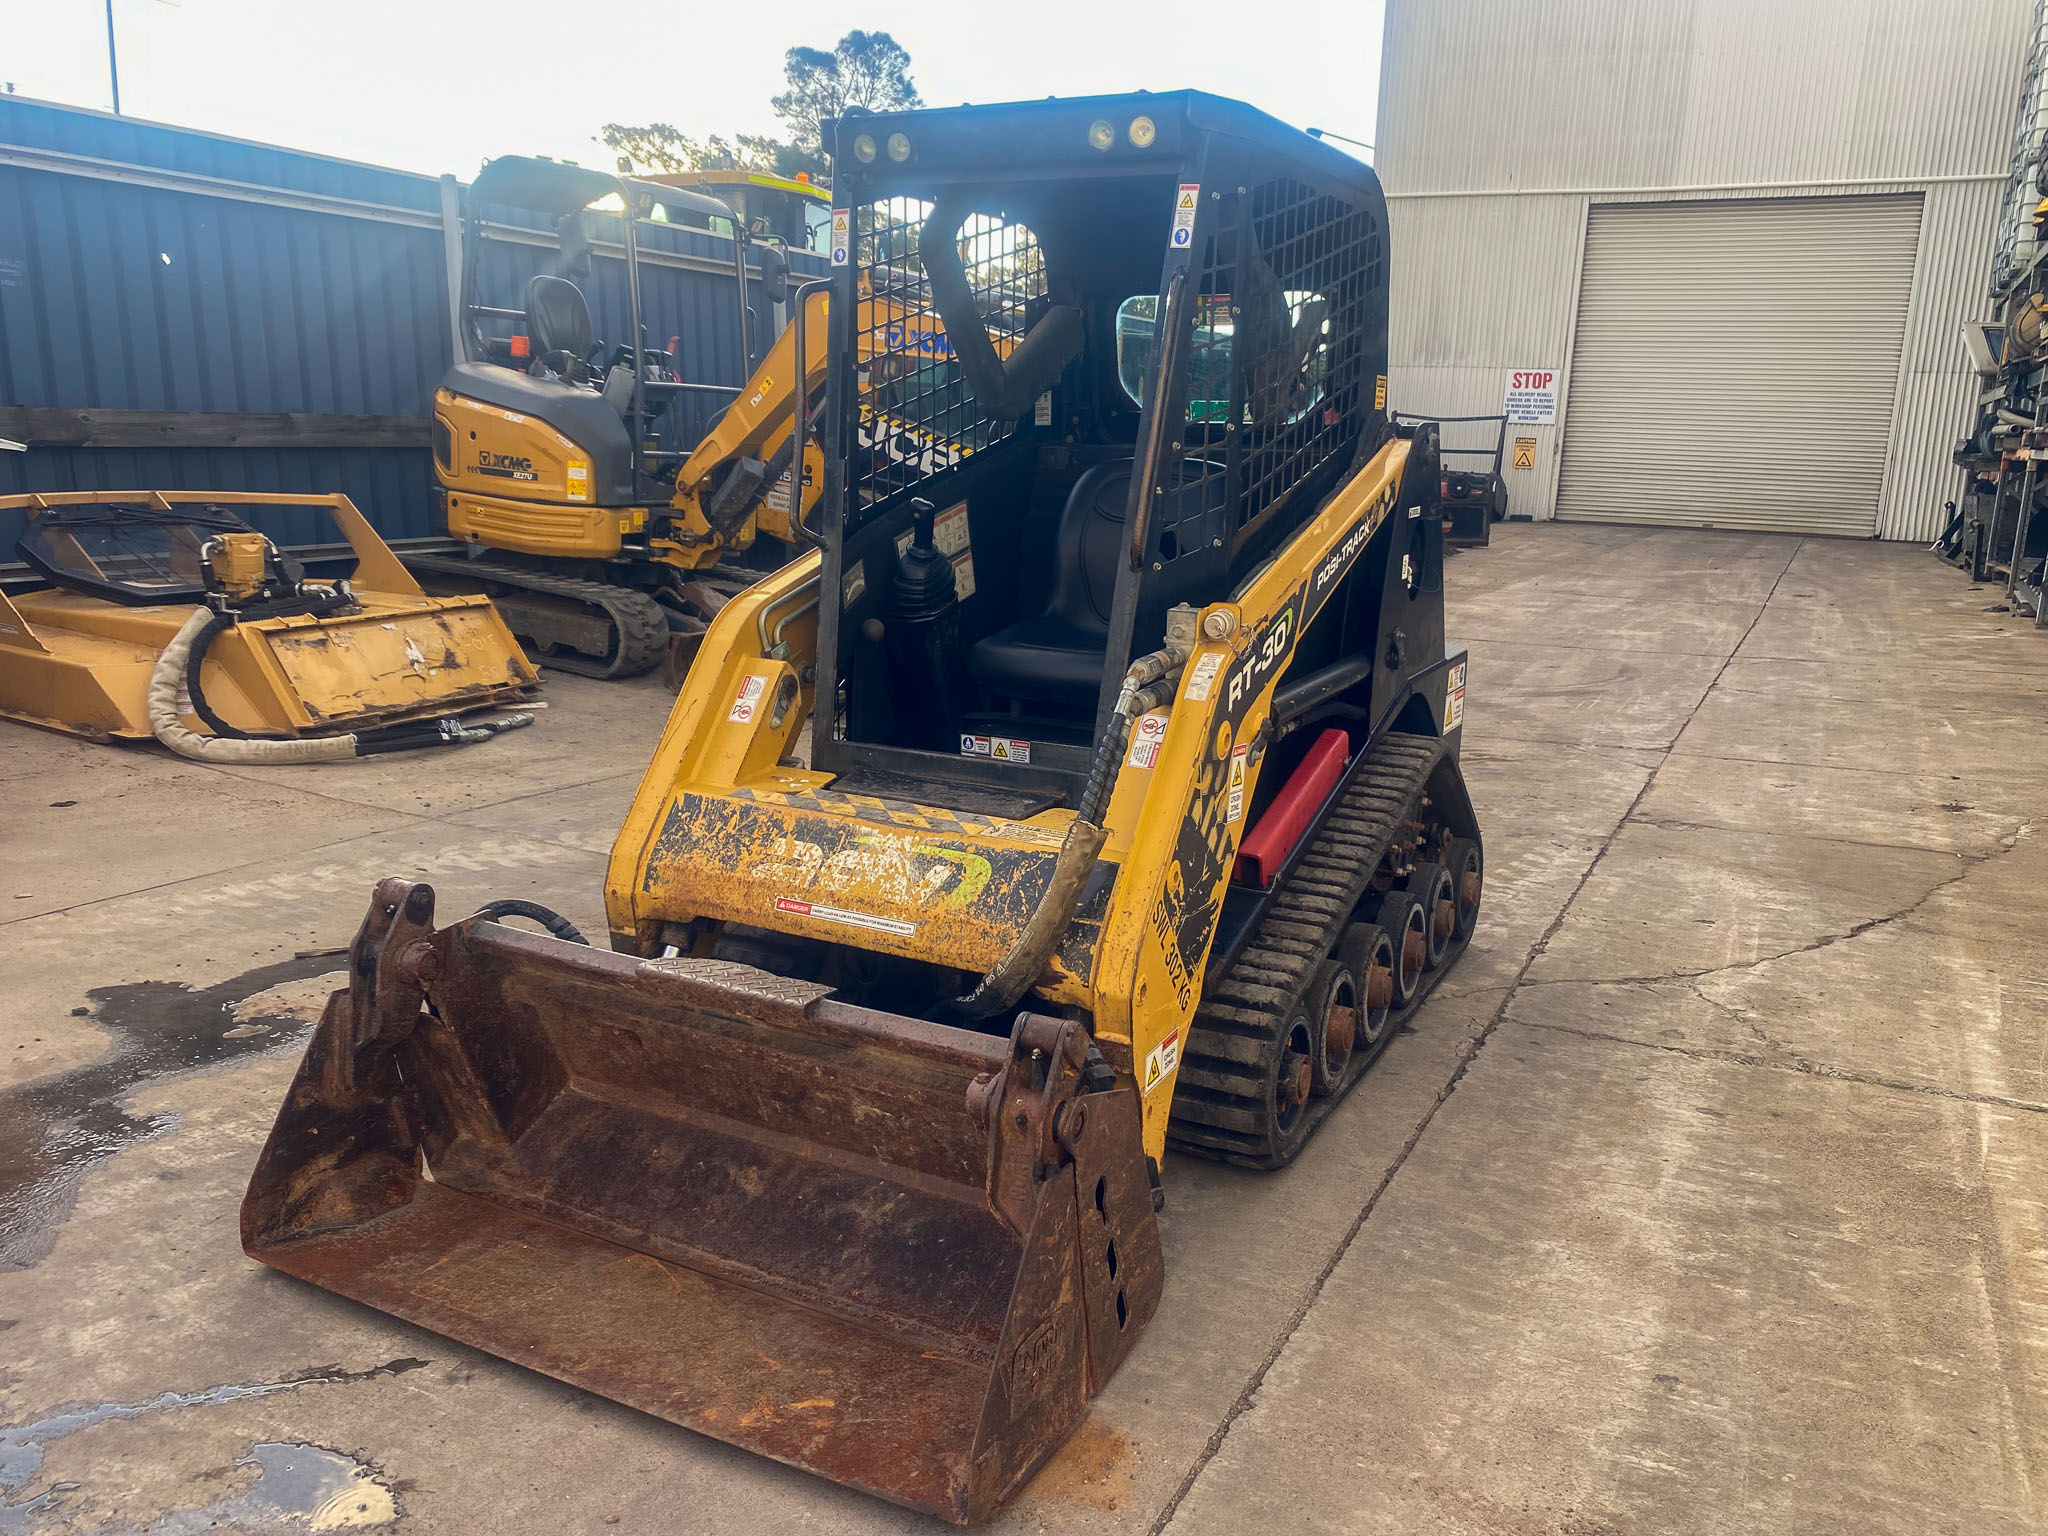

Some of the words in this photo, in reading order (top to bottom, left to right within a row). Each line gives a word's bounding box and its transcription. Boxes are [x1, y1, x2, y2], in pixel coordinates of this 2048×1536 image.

[1512, 372, 1553, 389] STOP
[493, 453, 532, 472] XCMG
[512, 471, 533, 480] XE27U
[1316, 519, 1372, 591] POSI-TRACK
[1228, 621, 1287, 713] RT-30
[786, 902, 809, 911] DANGER
[1152, 899, 1168, 949] SWL
[1164, 942, 1183, 988] 302
[1176, 982, 1192, 1014] KG
